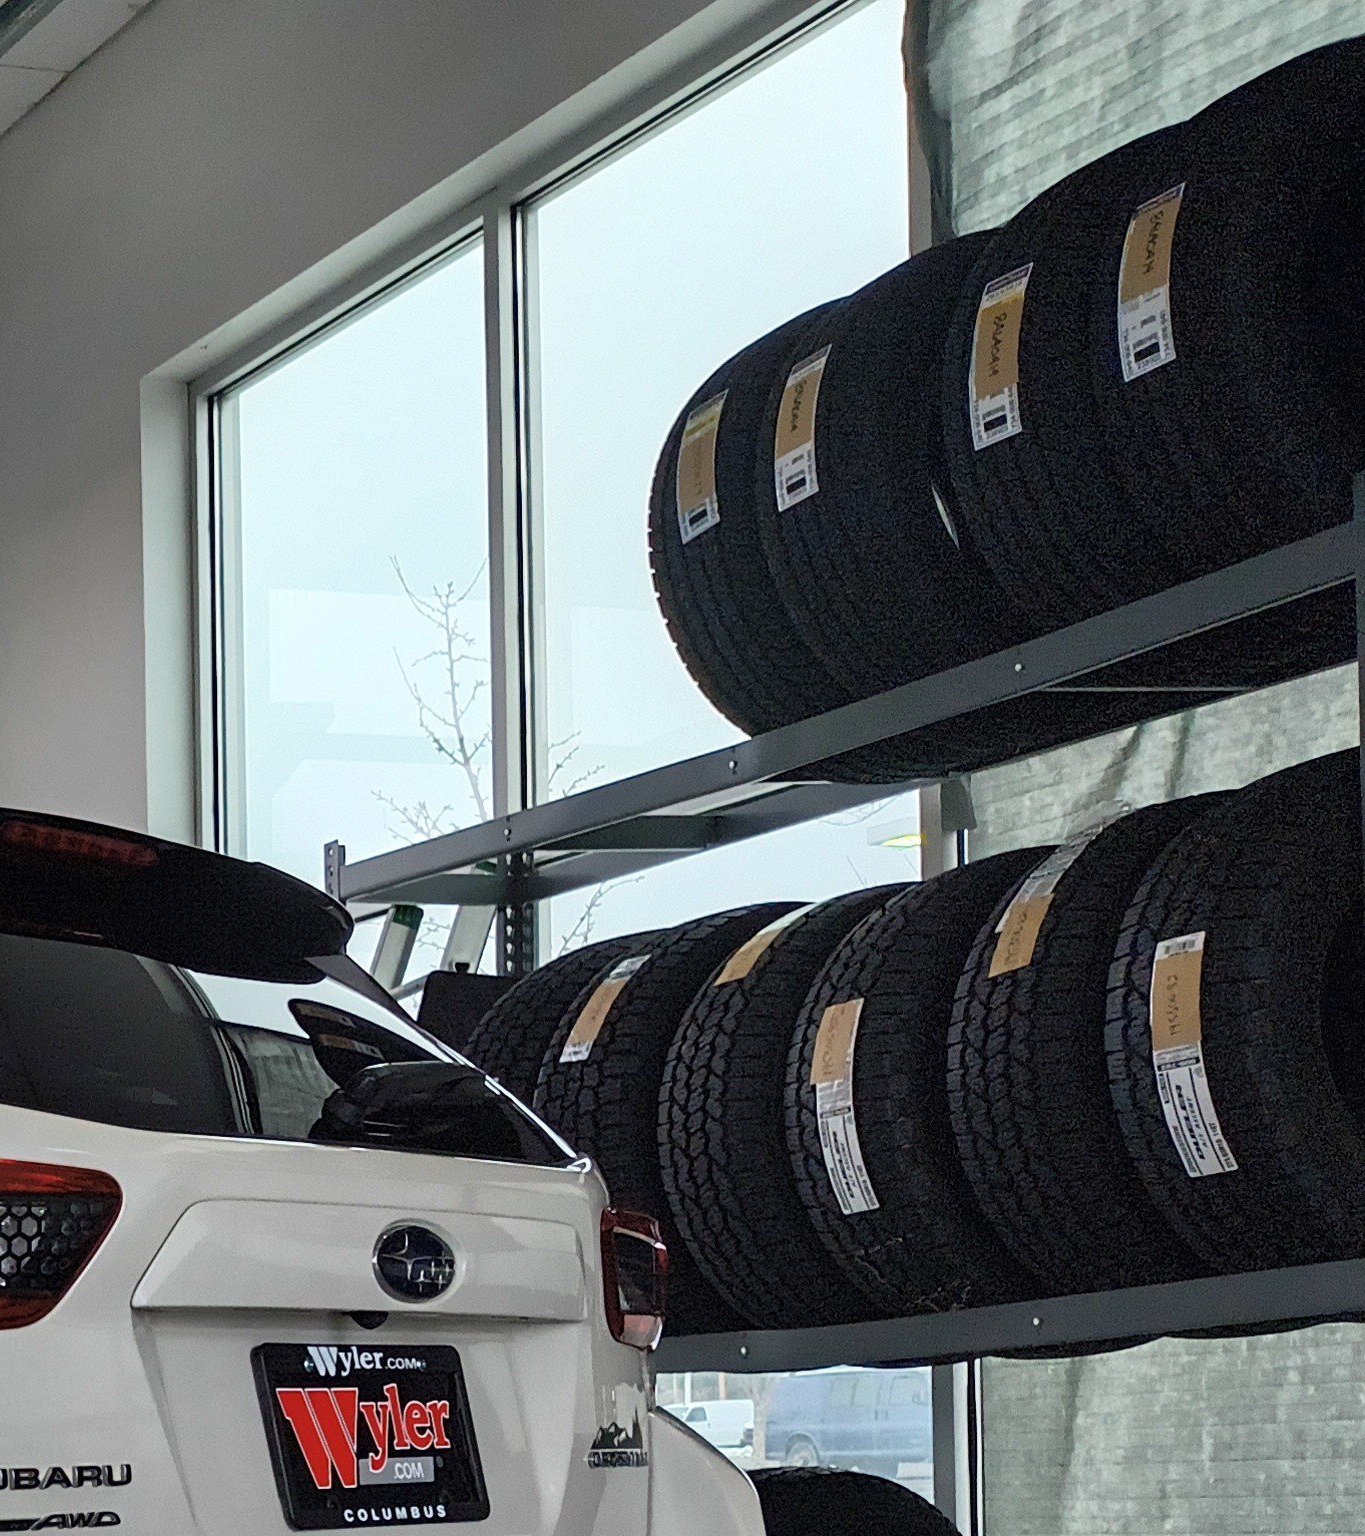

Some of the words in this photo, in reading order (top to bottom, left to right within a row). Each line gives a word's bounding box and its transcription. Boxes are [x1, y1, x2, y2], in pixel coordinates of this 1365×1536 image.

[275, 1383, 451, 1489] Wyler
[31, 1511, 121, 1531] AWD
[343, 1504, 447, 1523] COLUMBUS
